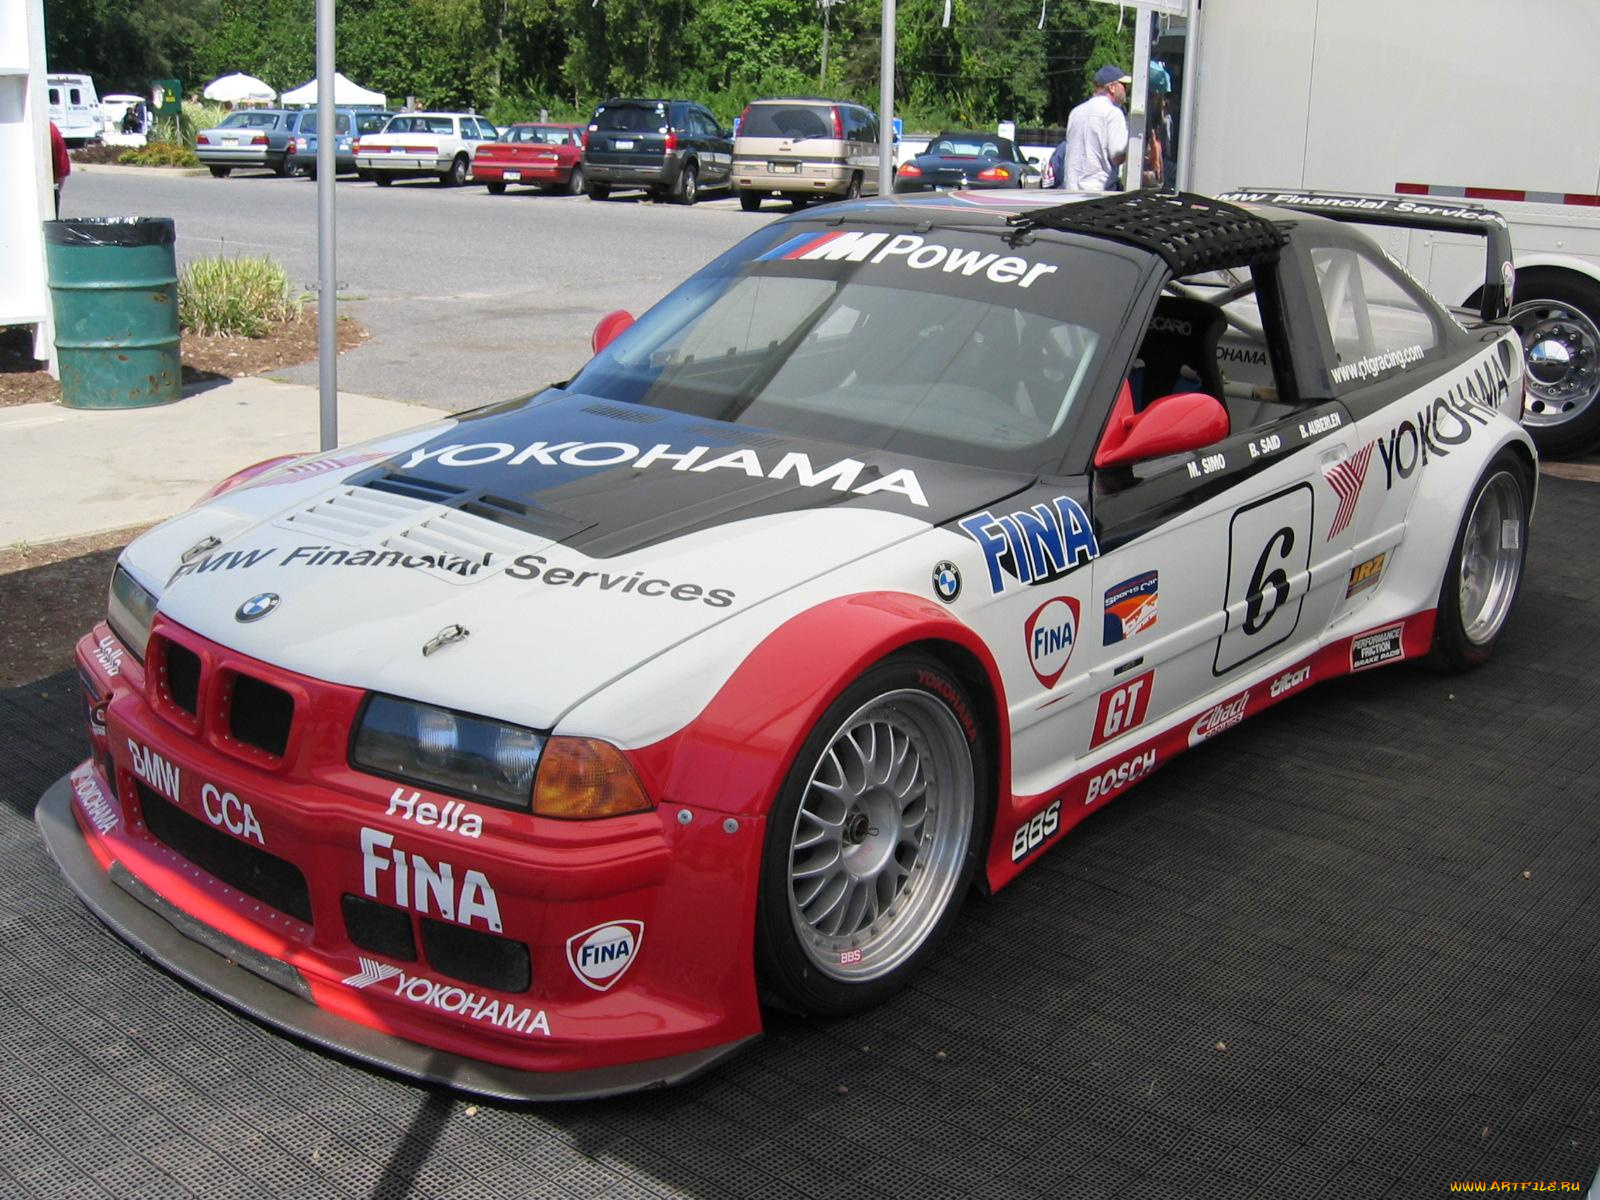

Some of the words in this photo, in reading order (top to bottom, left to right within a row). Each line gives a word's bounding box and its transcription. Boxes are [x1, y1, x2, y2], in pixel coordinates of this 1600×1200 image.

[1272, 193, 1387, 210] Financial
[1392, 202, 1508, 227] Services
[1149, 316, 1192, 336] CARO
[1216, 346, 1267, 365] OHAMA
[1330, 344, 1425, 384] www.ptgracing.com
[1249, 443, 1260, 458] B.
[1260, 434, 1281, 455] SAID
[1299, 423, 1308, 438] B.
[1309, 412, 1341, 434] AUBERLEN
[1376, 353, 1512, 491] YOKOHAMA
[400, 441, 930, 507] YOKOHAMA
[1187, 461, 1200, 479] M.
[1202, 453, 1226, 473] SIMO
[958, 495, 1100, 597] FINA
[278, 545, 494, 577] Financial
[504, 554, 737, 609] Services
[1105, 585, 1140, 607] Sports
[1242, 526, 1295, 636] 6
[1034, 622, 1073, 660] FINA
[1353, 628, 1401, 650] PERFORMANCE
[1354, 653, 1379, 668] BRAKE
[1380, 648, 1400, 659] PADS
[1361, 641, 1392, 659] FRICTION
[914, 667, 977, 743] YOKOHAMA
[1103, 679, 1145, 738] GT
[1187, 690, 1250, 748] Eibach
[127, 737, 181, 802] BMW
[201, 782, 265, 845] CCA
[1085, 749, 1157, 806] BOSCH
[75, 775, 120, 836] YOKOHAMA
[385, 787, 484, 839] Hella
[1011, 799, 1062, 864] BBS
[360, 826, 503, 934] FINA
[581, 939, 630, 967] FINA
[840, 949, 862, 965] BBS
[393, 972, 552, 1036] YOKOHAMA
